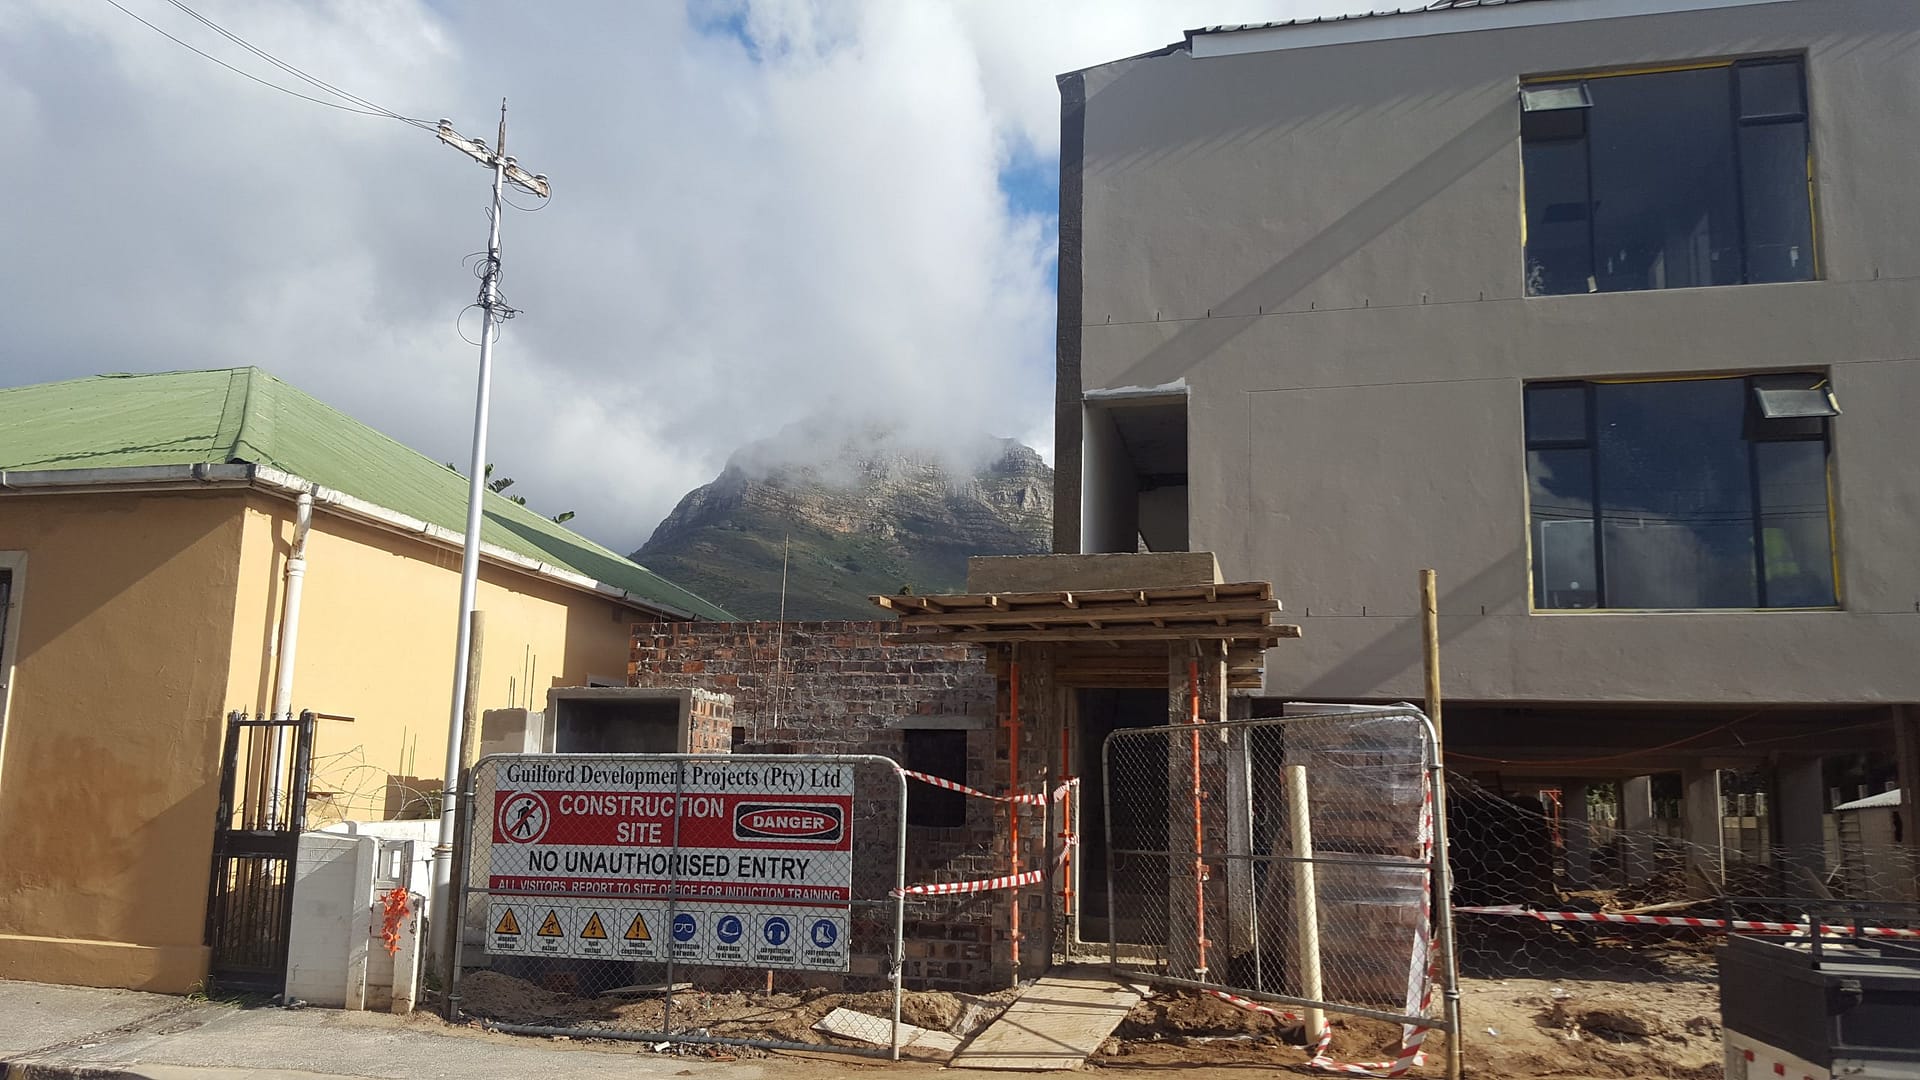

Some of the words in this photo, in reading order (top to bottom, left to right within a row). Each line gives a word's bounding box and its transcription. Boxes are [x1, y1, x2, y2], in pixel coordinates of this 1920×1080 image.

[507, 764, 575, 783] Guilford
[581, 765, 687, 789] Development
[692, 766, 758, 790] Projects
[764, 767, 805, 792] (Pty)
[810, 769, 840, 788] Ltd
[559, 795, 724, 818] CONSTRUCTION
[617, 822, 662, 843] SITE
[752, 816, 825, 830] DANGER
[529, 850, 558, 871] NO
[565, 851, 730, 877] UNAUTHORISED
[738, 856, 810, 880] ENTRY
[520, 880, 566, 892] VISITORS
[572, 881, 614, 893] REPORT
[617, 882, 630, 894] TO
[633, 883, 656, 895] SITE
[701, 885, 722, 897] FOR
[725, 886, 785, 898] INDUCTION
[788, 888, 840, 901] TRAINING
